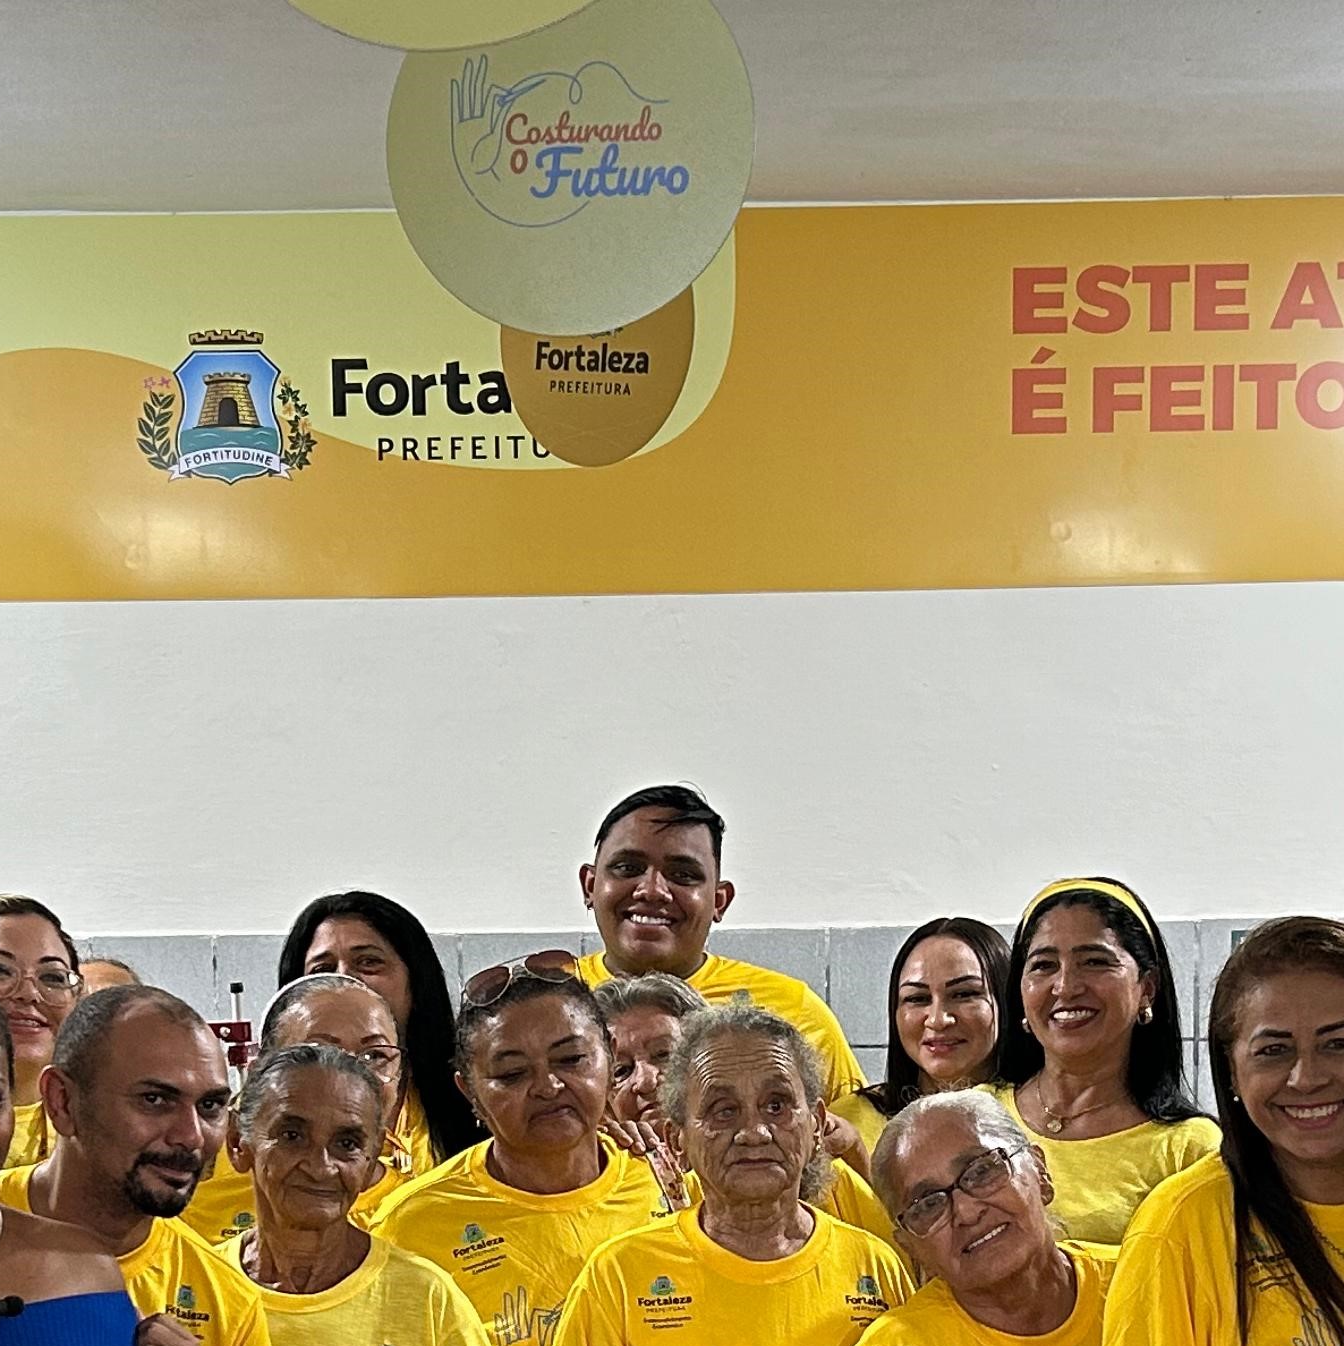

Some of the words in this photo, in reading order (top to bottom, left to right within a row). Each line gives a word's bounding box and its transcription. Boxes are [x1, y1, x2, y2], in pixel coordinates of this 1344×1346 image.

[506, 105, 662, 145] Costurando
[530, 143, 689, 198] Futuro
[1012, 263, 1250, 334] ESTE
[535, 340, 650, 375] Fortaleza
[331, 358, 512, 418] Forta
[549, 379, 632, 397] PREFEITURA
[1011, 346, 1068, 435] É
[184, 449, 274, 469] FORTITUDINE
[377, 435, 551, 461] PREFEITU
[452, 1236, 505, 1259] Fortaleza
[637, 1295, 693, 1307] Fortaleza
